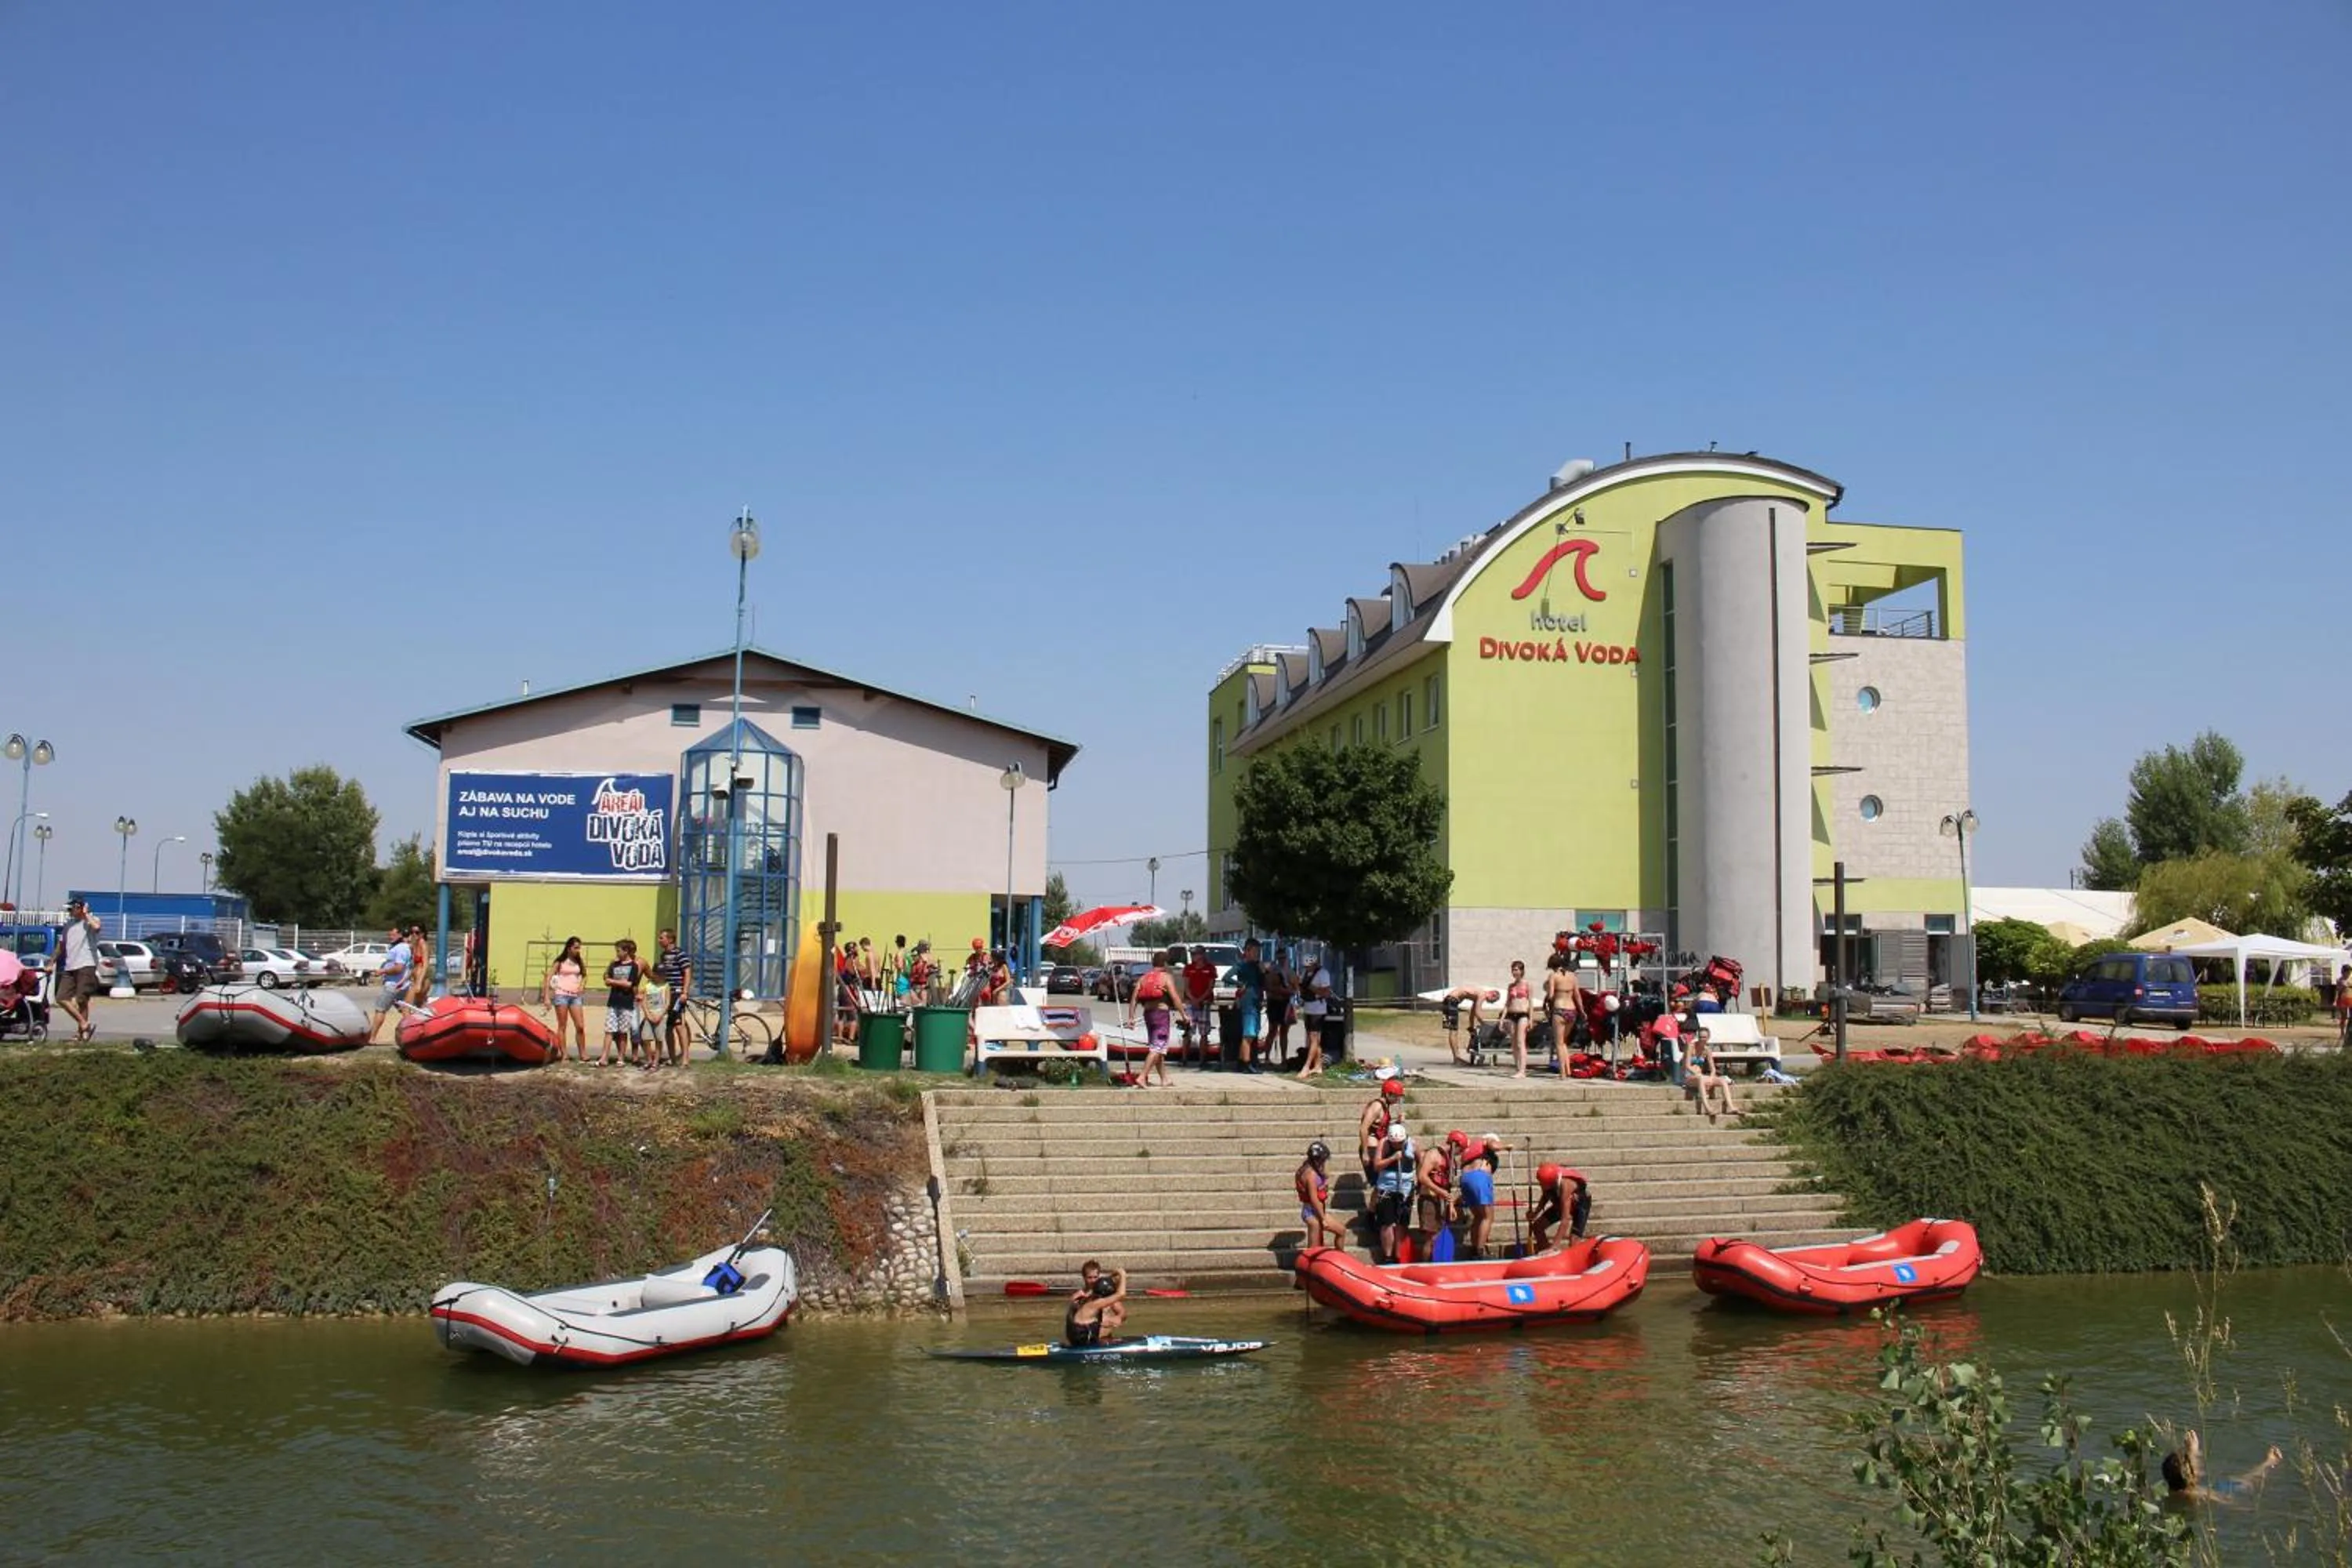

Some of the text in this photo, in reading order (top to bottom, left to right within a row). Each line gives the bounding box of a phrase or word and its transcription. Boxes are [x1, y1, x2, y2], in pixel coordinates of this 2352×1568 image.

[1530, 609, 1587, 632] hotel
[1479, 636, 1641, 665] DIVOKÁ VODA
[459, 789, 576, 805] ZÁBAVA NA VODE
[459, 805, 549, 818] AJ NA SUCHU
[588, 810, 662, 842] DIVOKÁ
[611, 843, 664, 869] VODA
